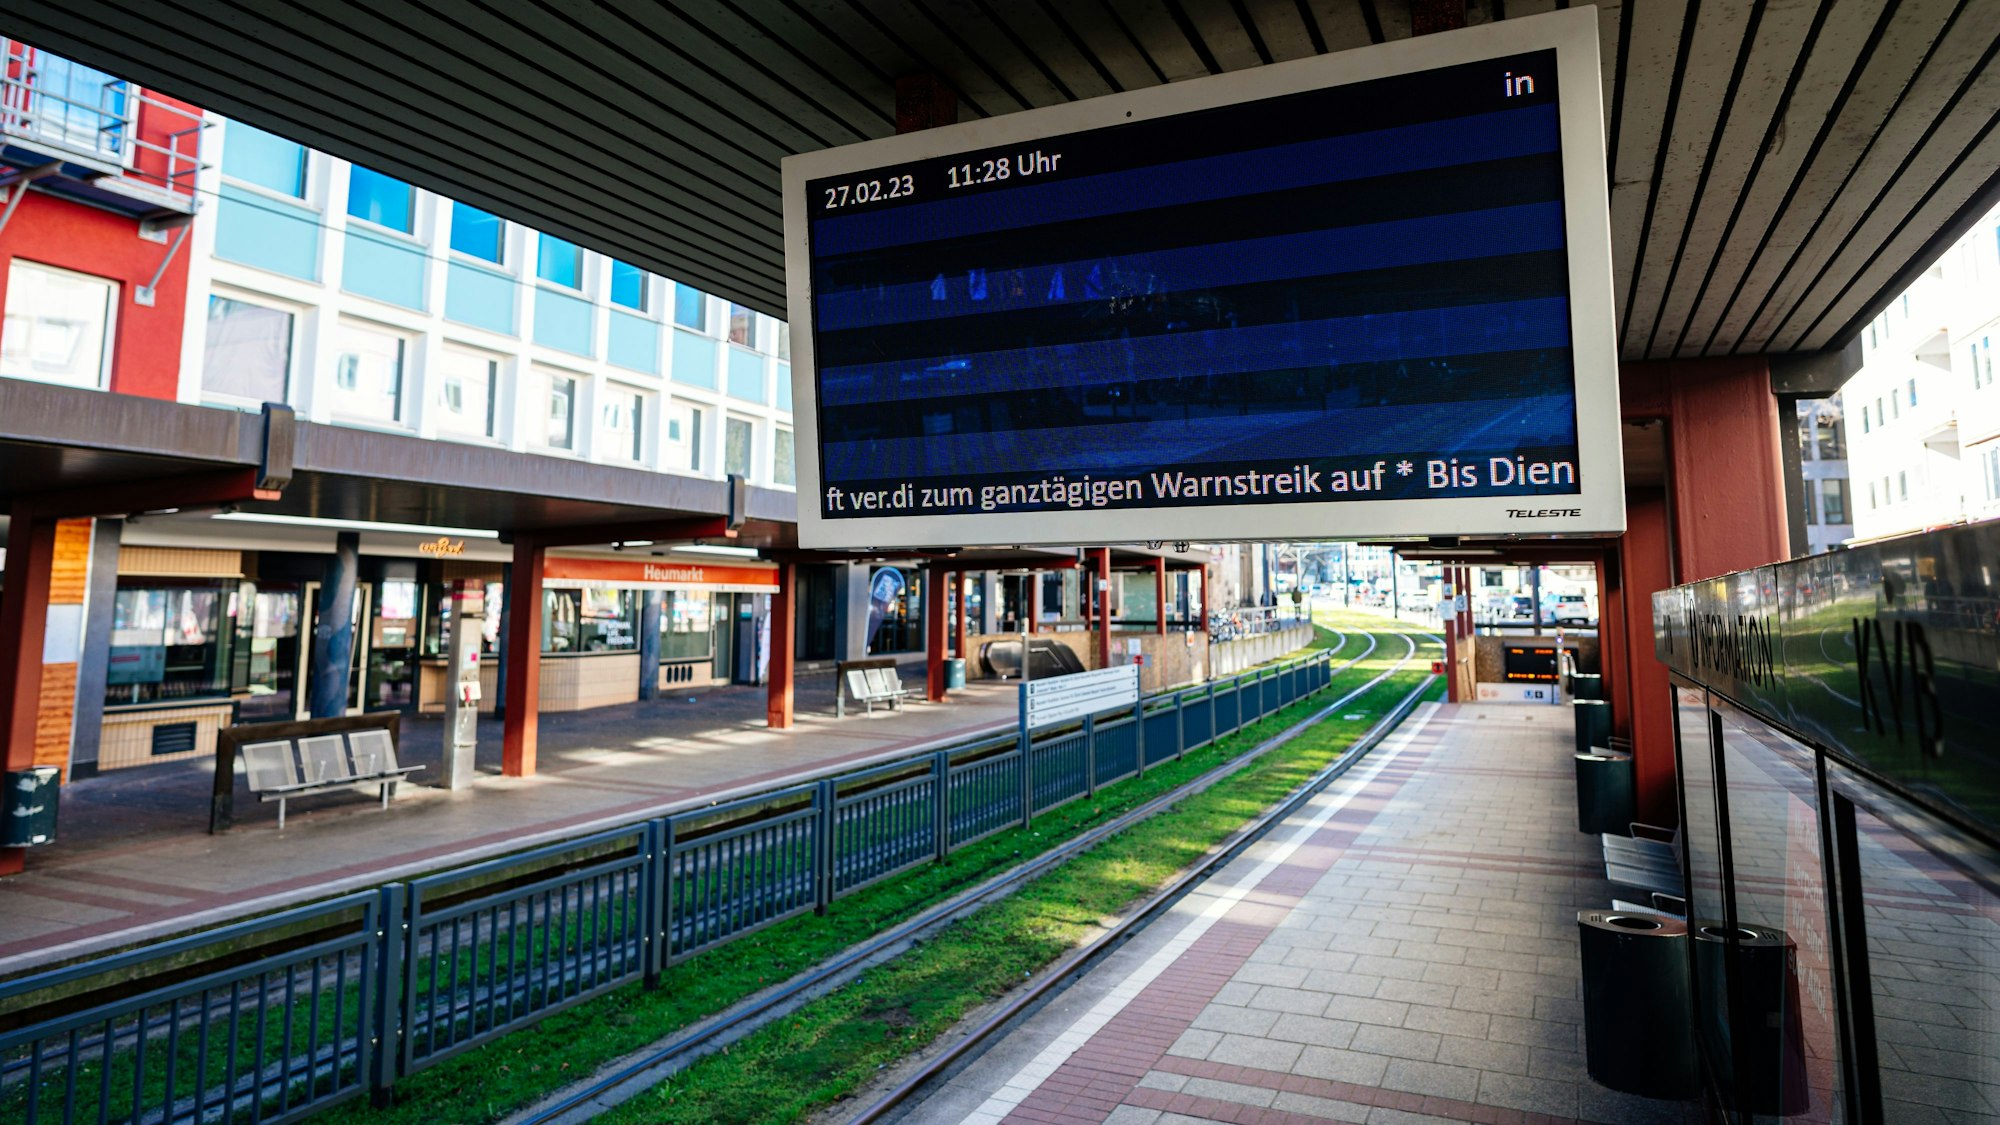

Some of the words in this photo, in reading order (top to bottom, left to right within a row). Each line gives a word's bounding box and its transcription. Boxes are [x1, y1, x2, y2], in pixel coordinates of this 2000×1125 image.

[1505, 71, 1534, 97] in
[825, 174, 915, 209] 27.02.23
[947, 157, 1010, 188] 11:28
[1017, 150, 1062, 176] Uhr
[826, 486, 845, 511] ft
[850, 483, 914, 510] ver.di
[922, 486, 974, 508] zum
[981, 475, 1143, 511] ganztägigen
[1151, 464, 1322, 499] Warnstreik
[1330, 460, 1386, 493] auf
[1427, 457, 1478, 490] Bis
[1489, 454, 1575, 487] Dien
[1505, 508, 1582, 519] TELESTE
[643, 564, 704, 582] Heumarkt
[1699, 614, 1776, 693] INFORMATION
[1853, 617, 1945, 758] KVB
